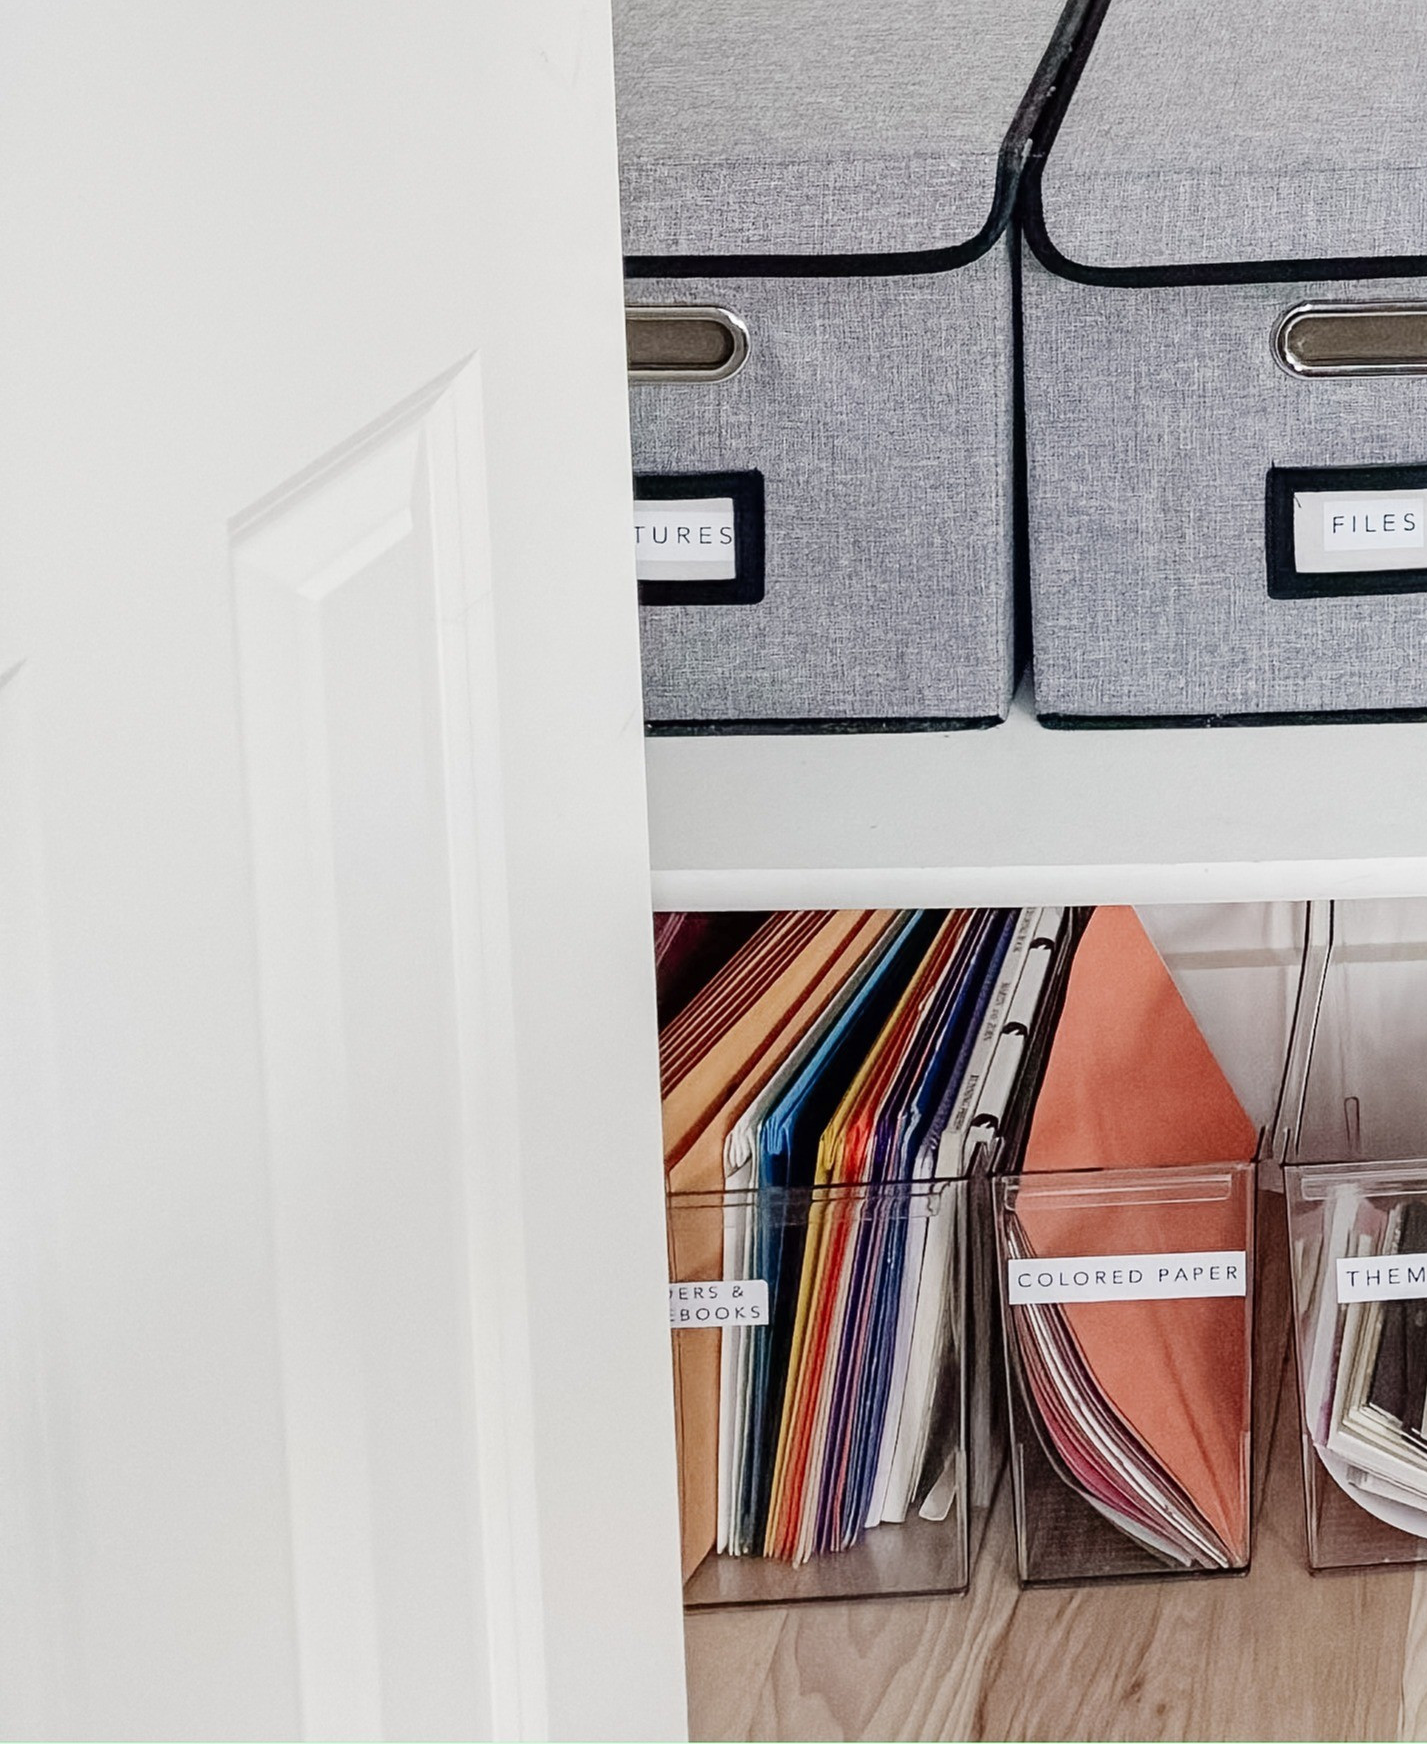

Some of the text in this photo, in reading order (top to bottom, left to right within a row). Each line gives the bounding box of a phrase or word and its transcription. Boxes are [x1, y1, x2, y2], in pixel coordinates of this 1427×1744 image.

[1332, 512, 1416, 534] FILES
[634, 525, 733, 545] TURES
[1017, 1265, 1238, 1288] COLORED PAPER
[731, 1285, 744, 1299] &
